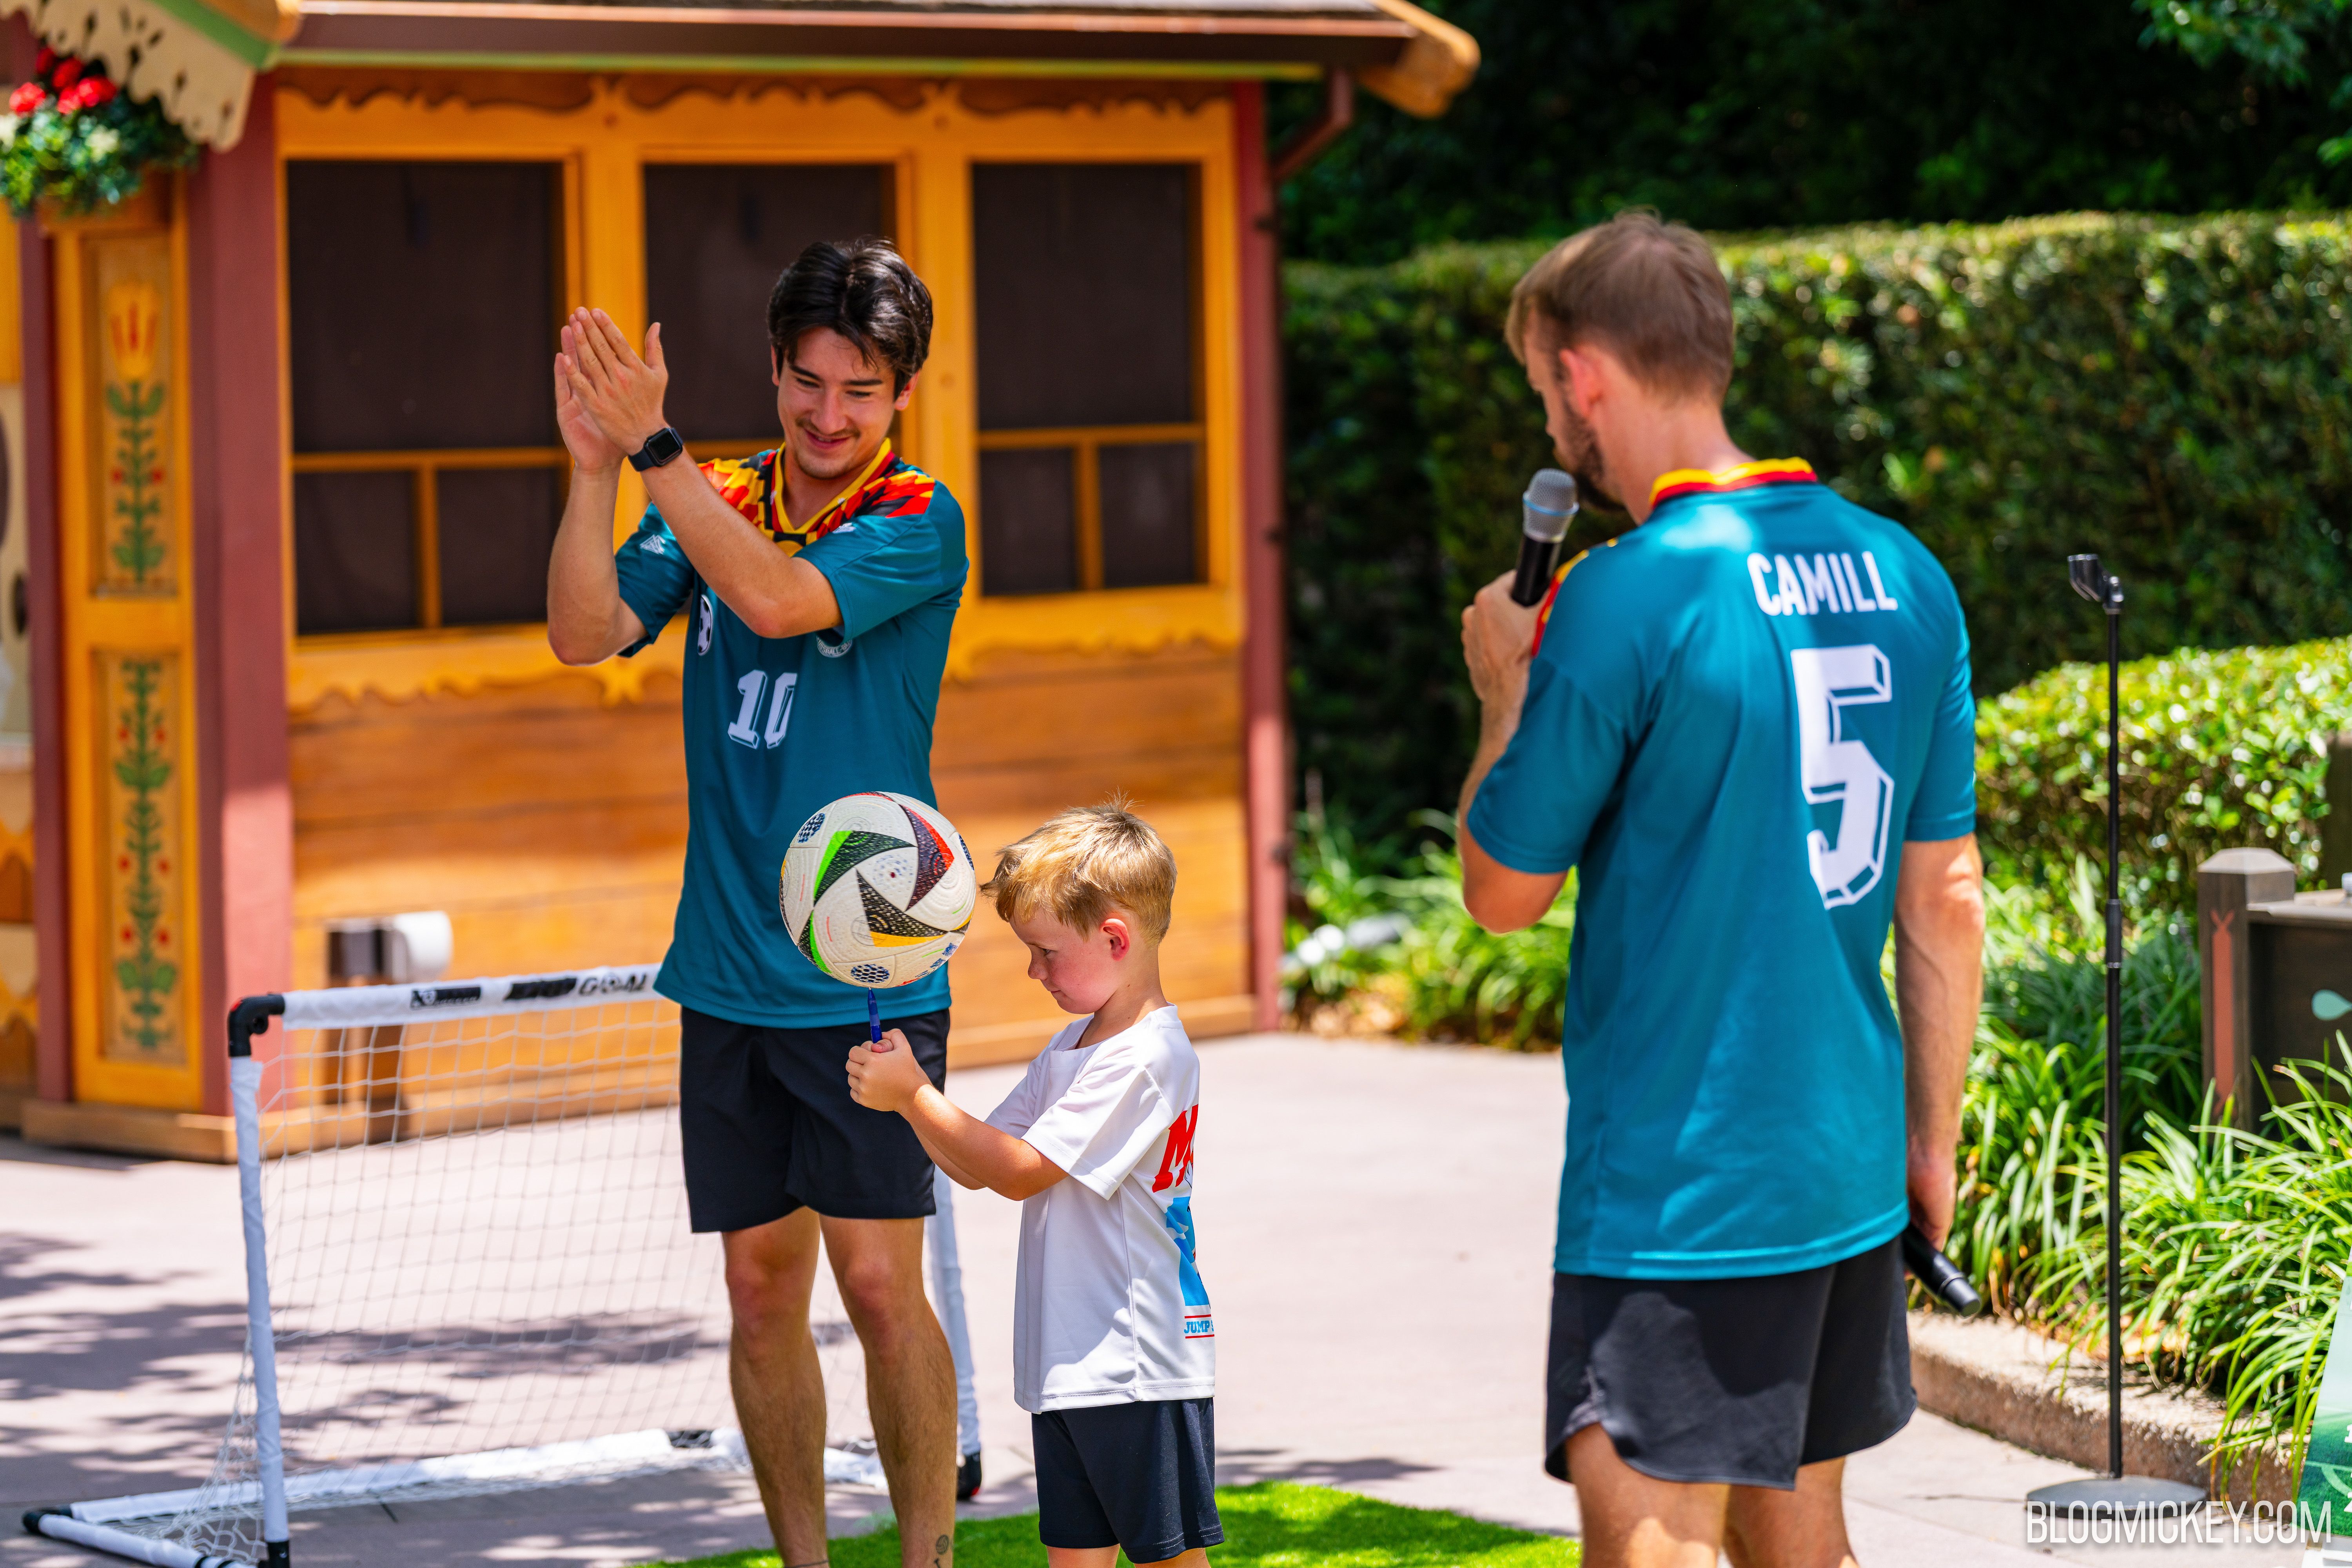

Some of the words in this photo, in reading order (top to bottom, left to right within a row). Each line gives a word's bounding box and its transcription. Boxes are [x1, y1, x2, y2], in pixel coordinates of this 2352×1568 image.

[1747, 551, 1898, 616] CAMILL
[727, 669, 798, 750] 10
[1790, 644, 1895, 910] 5
[1184, 1320, 1210, 1334] JUMP
